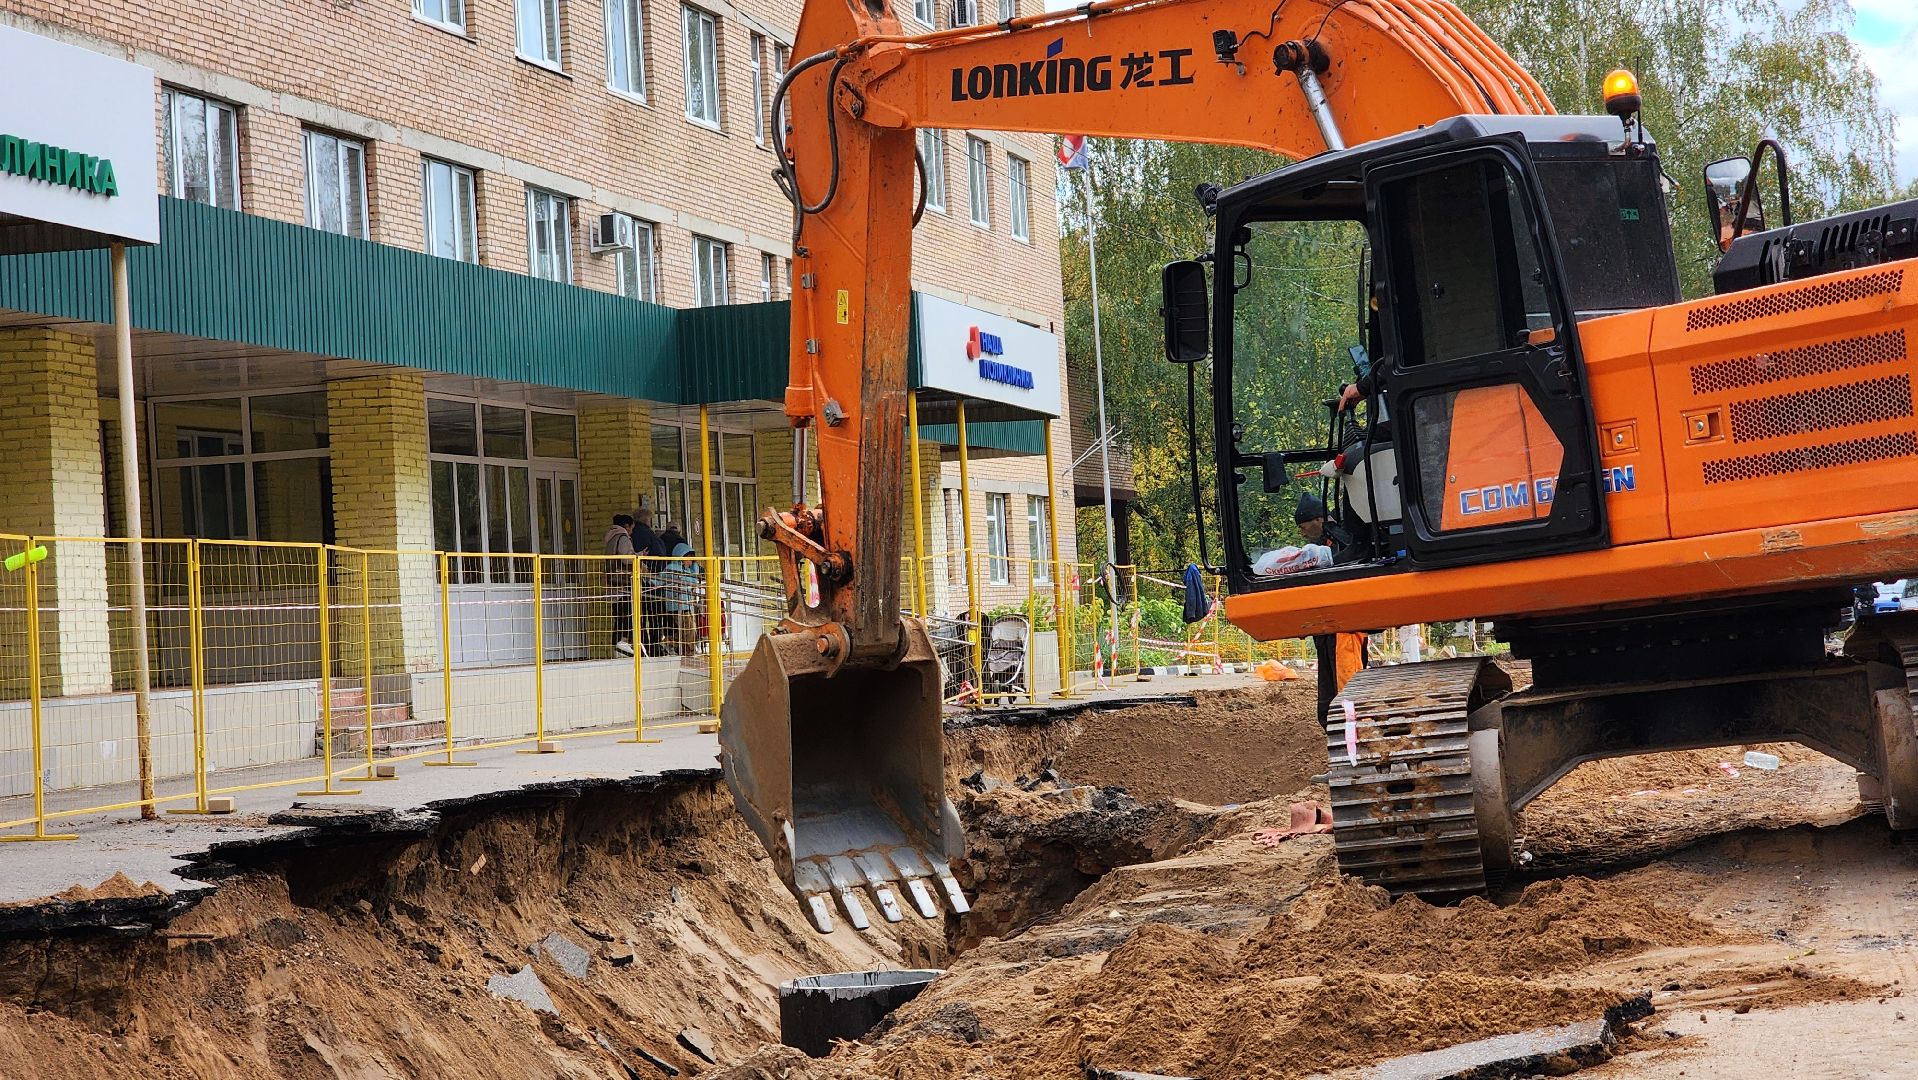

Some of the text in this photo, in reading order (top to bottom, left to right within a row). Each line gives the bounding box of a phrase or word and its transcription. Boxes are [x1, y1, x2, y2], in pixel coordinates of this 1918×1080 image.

[951, 37, 1195, 102] LONKING 龙工
[0, 134, 119, 198] ЛИНИКА
[979, 331, 1004, 356] НАША
[979, 359, 1034, 389] ПОЛИКЛИНИКА
